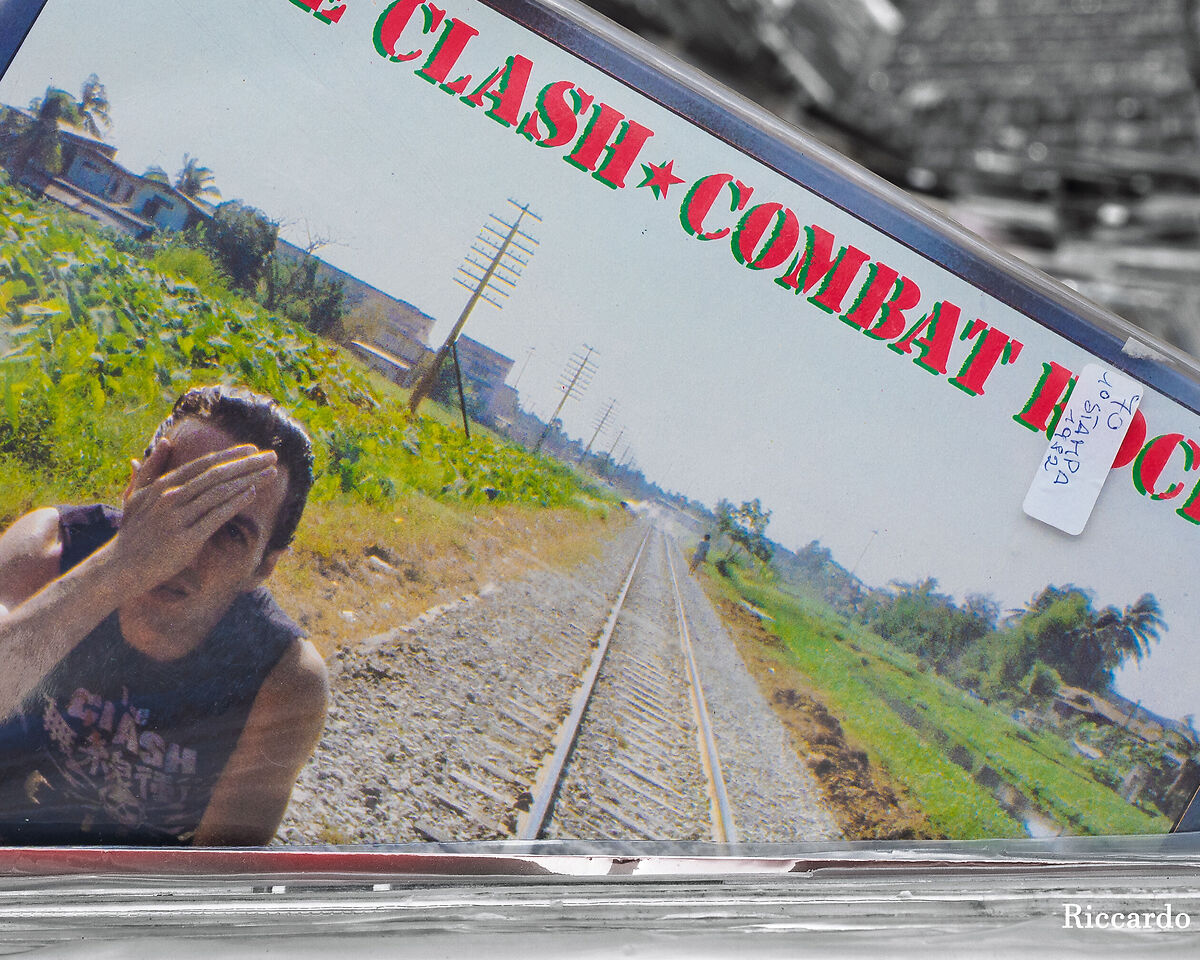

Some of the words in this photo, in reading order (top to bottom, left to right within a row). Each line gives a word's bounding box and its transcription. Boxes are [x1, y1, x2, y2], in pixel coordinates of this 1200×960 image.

[679, 173, 1024, 397] COMBAT
[1044, 408, 1075, 471] 1982
[1053, 399, 1102, 485] STAMPA
[1107, 394, 1140, 430] 70
